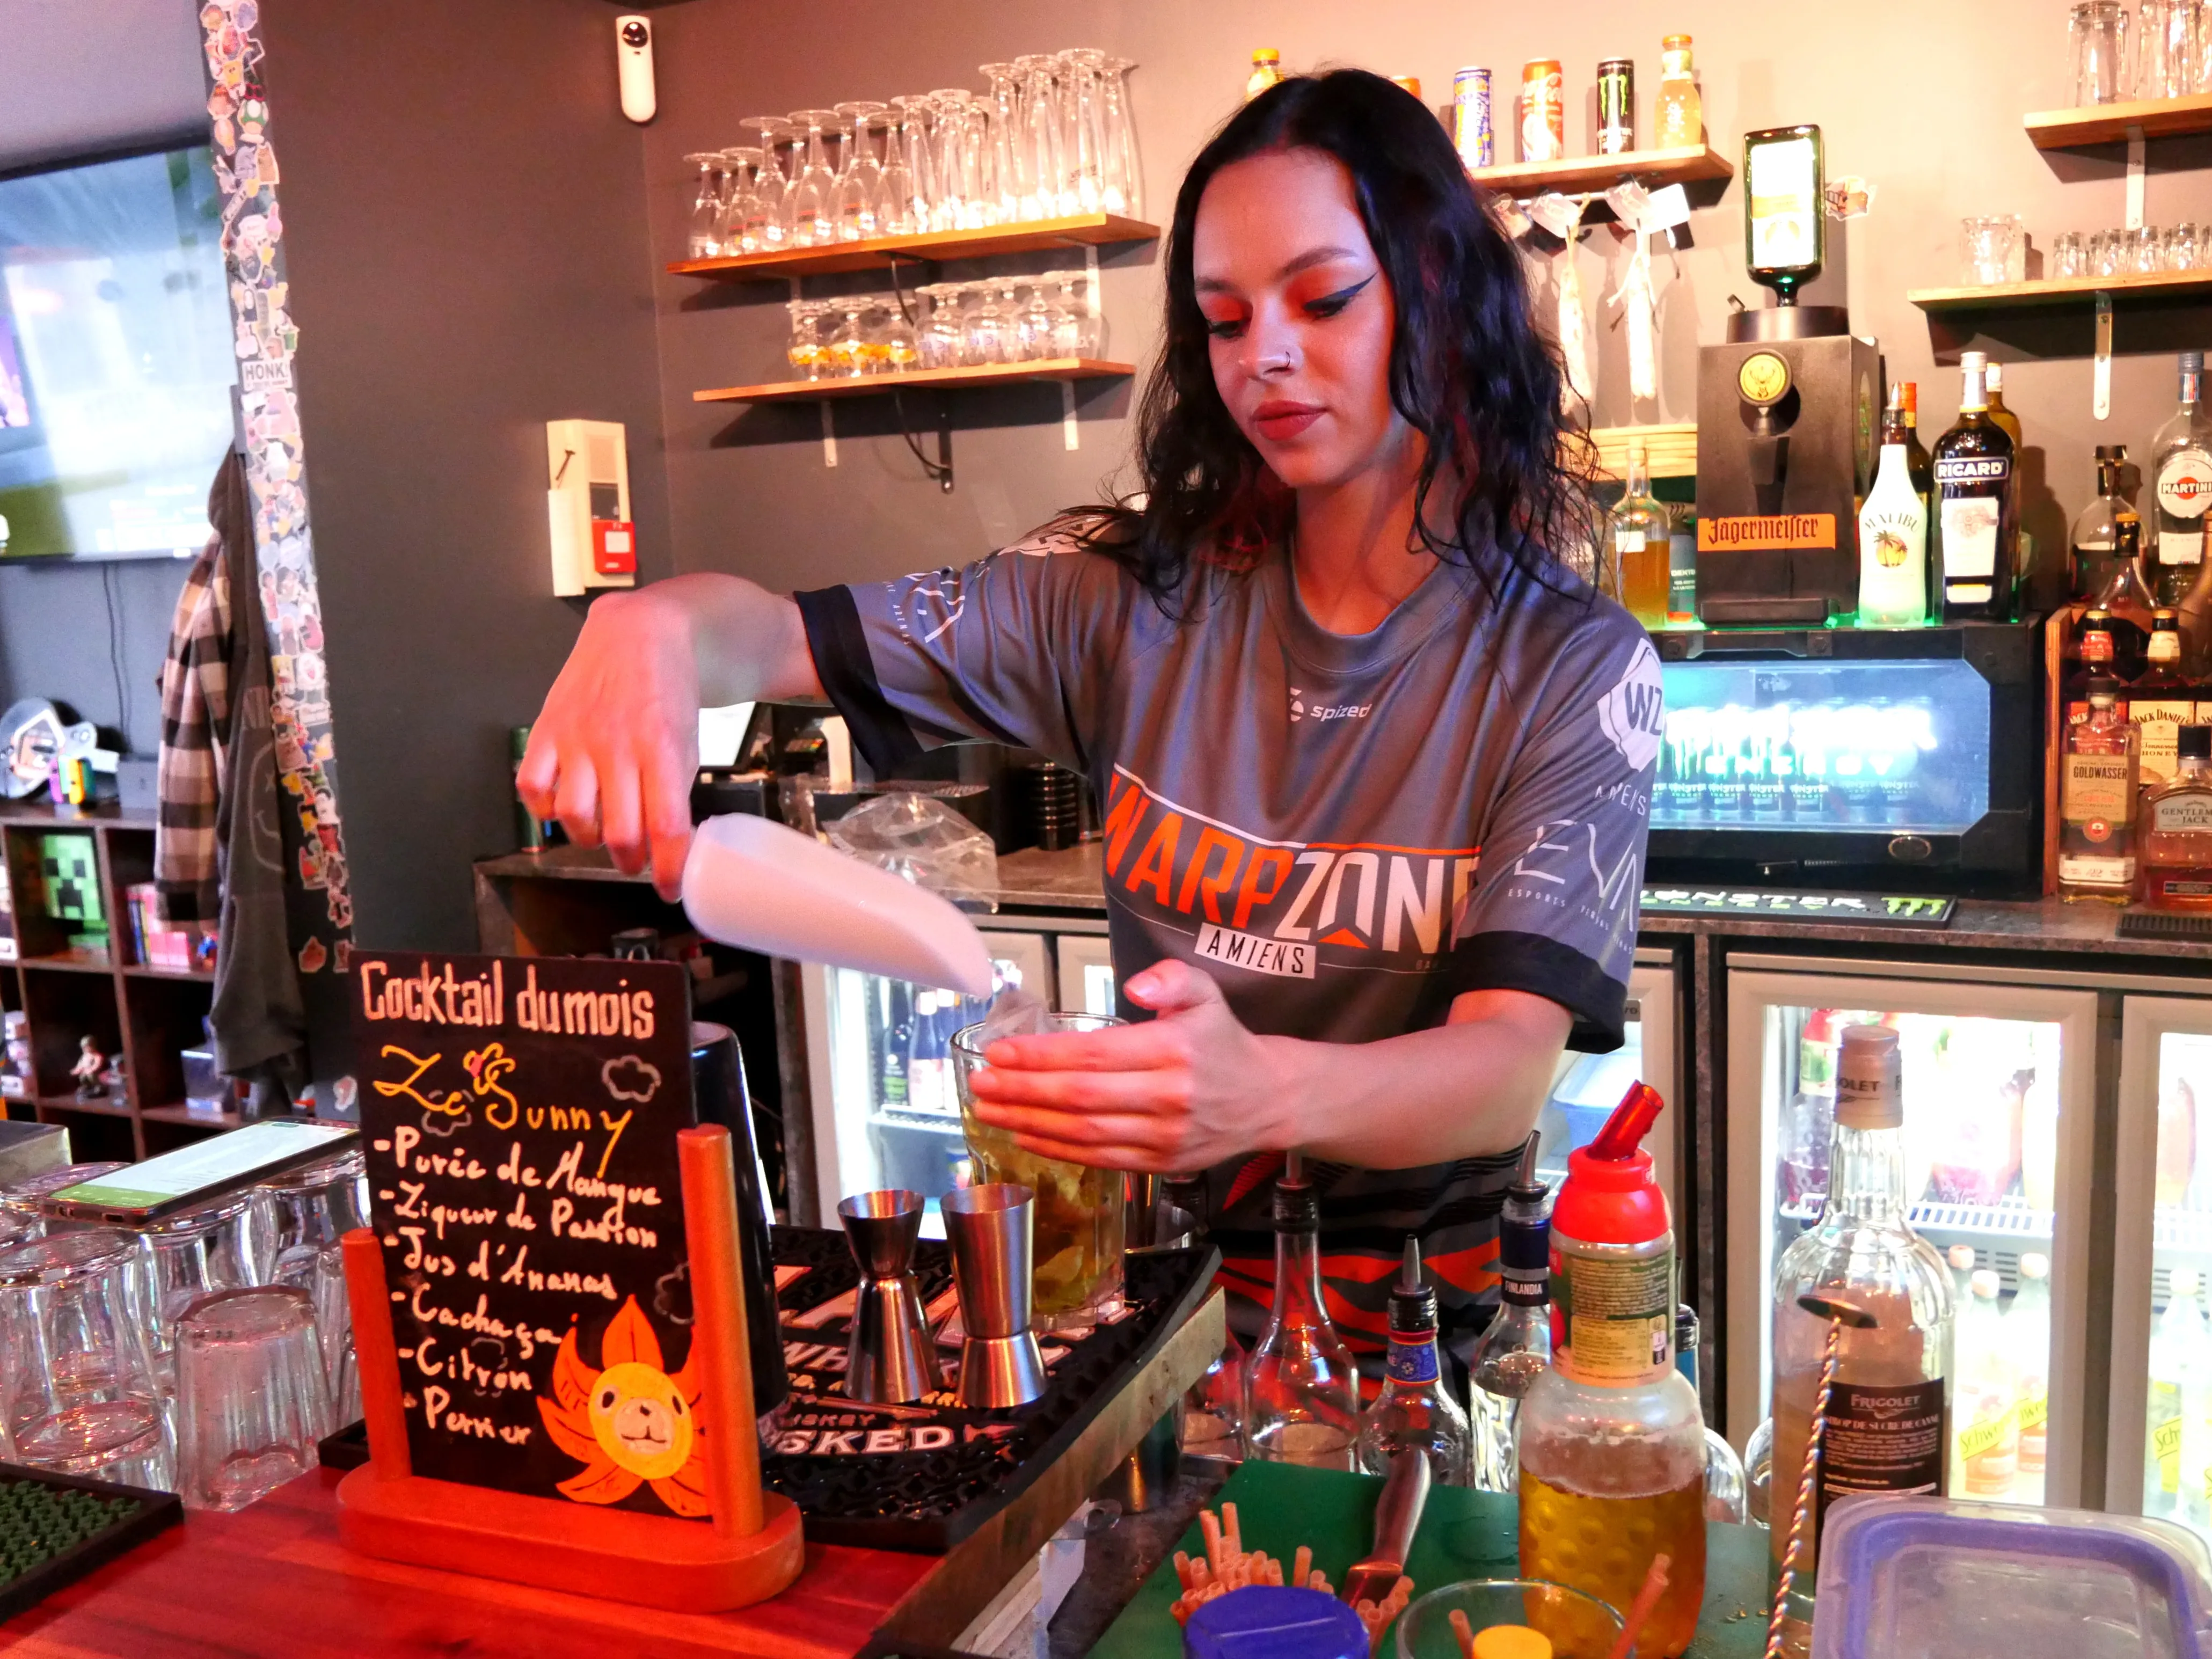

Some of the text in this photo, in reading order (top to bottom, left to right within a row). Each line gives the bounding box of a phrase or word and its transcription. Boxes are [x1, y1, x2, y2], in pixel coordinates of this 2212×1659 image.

[1937, 462, 2003, 478] RICARD
[2162, 482, 2212, 494] MARTINI
[1864, 512, 1921, 533] MALIBU
[1310, 704, 1371, 722] spized
[2134, 712, 2155, 725] JACK
[2074, 766, 2128, 780] GOLDWASSER
[2161, 808, 2212, 816] GENTLEM
[2182, 816, 2209, 824] JACK
[1507, 888, 1566, 908] ESPORTS
[1206, 930, 1305, 975] AMIENS
[360, 959, 503, 1027] Cocktail
[1505, 1280, 1543, 1296] FINLANDIA
[416, 1338, 532, 1391] Citron
[1851, 1394, 1921, 1409] FRIGOLET
[776, 1426, 955, 1456] SKED
